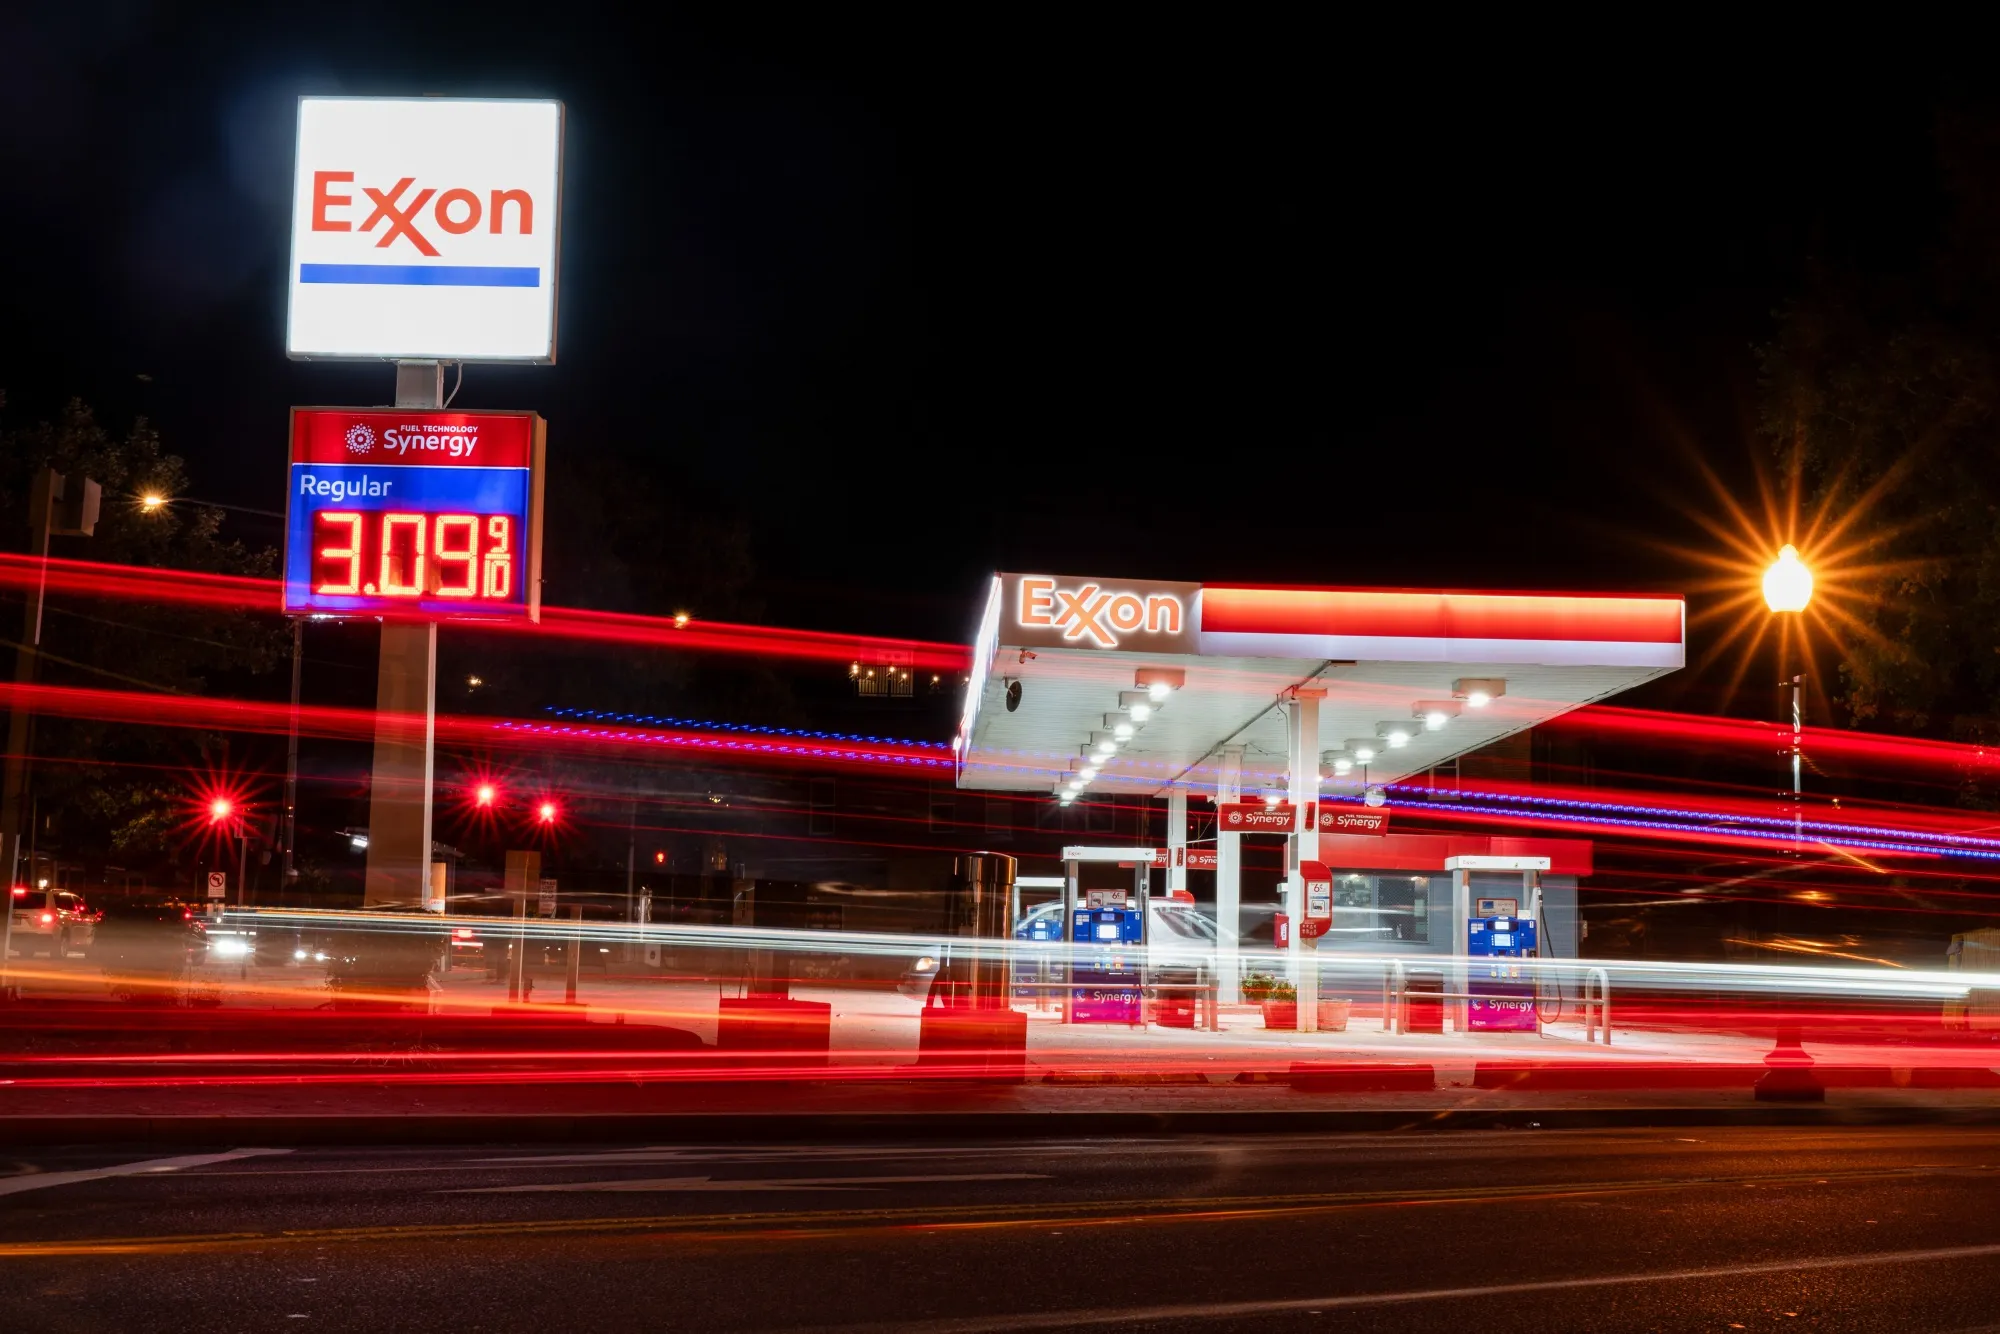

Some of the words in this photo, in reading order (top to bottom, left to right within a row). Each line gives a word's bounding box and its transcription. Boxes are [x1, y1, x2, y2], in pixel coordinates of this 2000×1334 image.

[312, 171, 533, 257] Exxon
[400, 424, 420, 432] FUEL
[423, 425, 478, 433] TECHNOLOGY
[383, 429, 478, 457] Synergy
[300, 474, 392, 501] Regular
[317, 512, 479, 597] 3.09
[1020, 579, 1181, 646] Exxon
[1246, 813, 1291, 826] Synergy
[1337, 816, 1382, 829] Synergy
[1199, 856, 1217, 865] Syne
[1093, 990, 1138, 1004] Synergy
[1489, 999, 1533, 1012] Synergy
